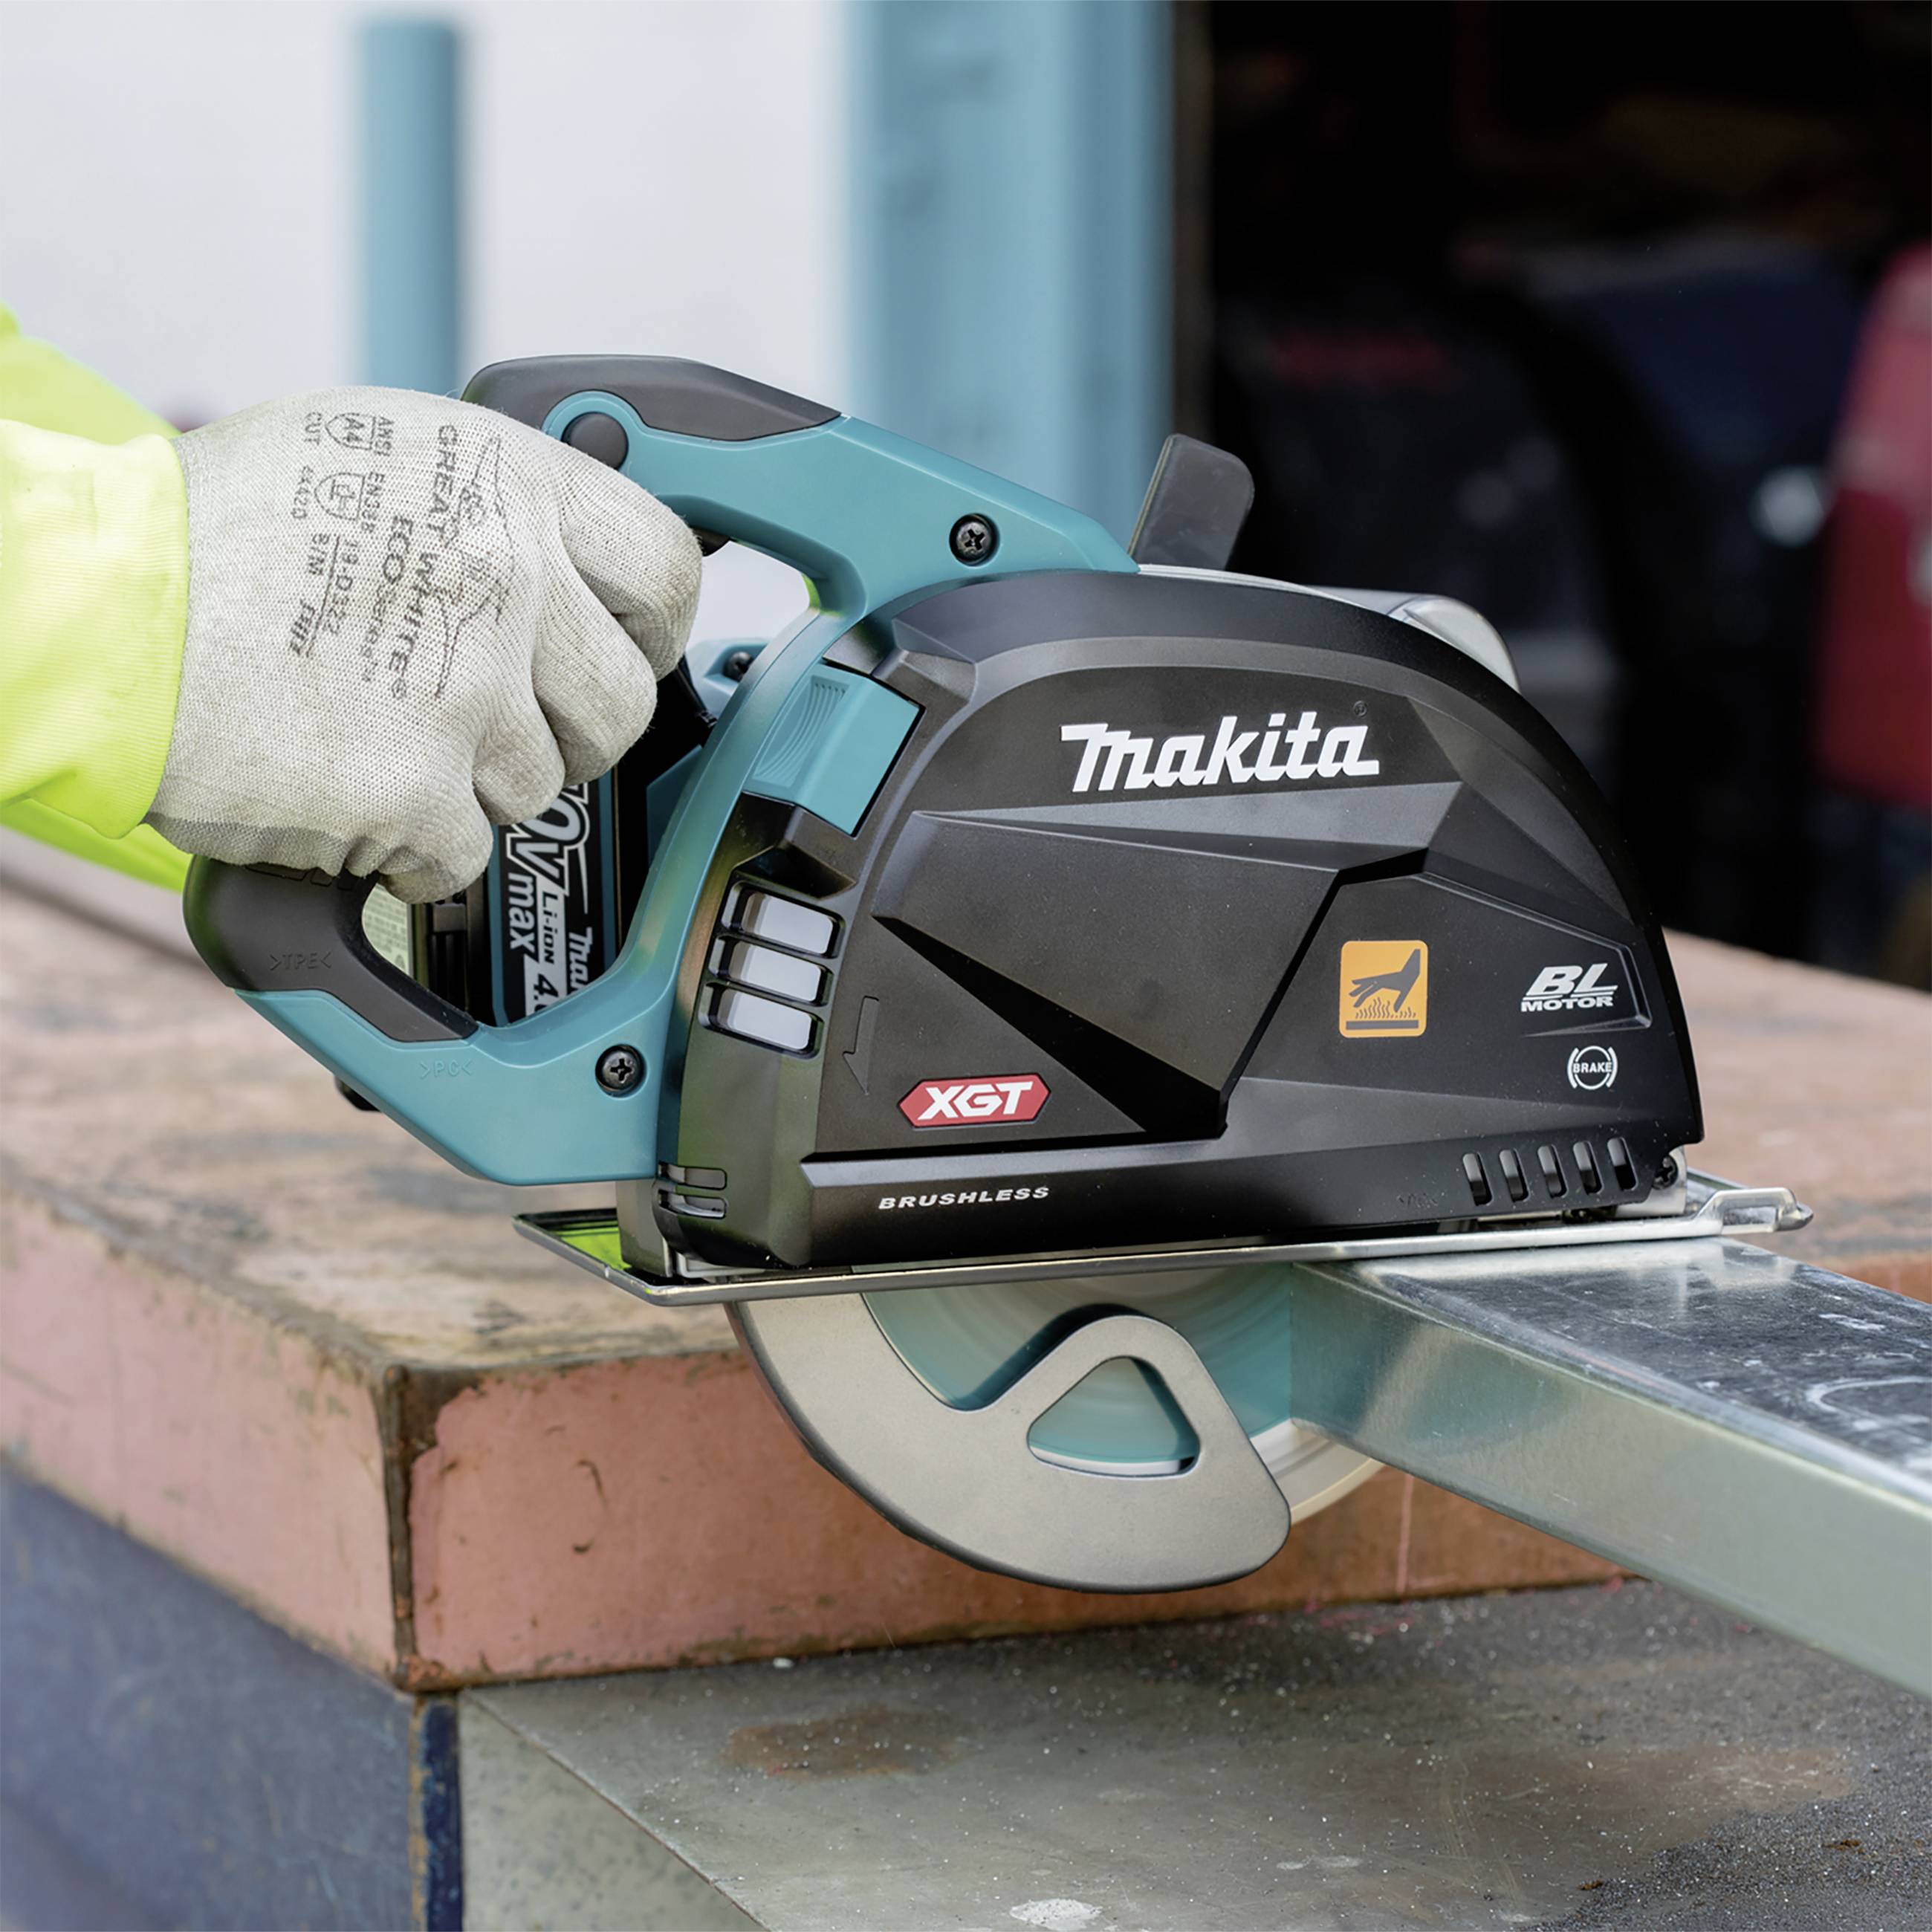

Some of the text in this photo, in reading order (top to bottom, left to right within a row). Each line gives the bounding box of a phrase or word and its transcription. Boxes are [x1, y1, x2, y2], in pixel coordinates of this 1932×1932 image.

[301, 412, 323, 444] CUT
[342, 417, 360, 446] A4
[375, 415, 395, 457] ANSI
[426, 425, 458, 532] GREAT
[363, 473, 386, 532] EN388
[506, 873, 539, 950] max
[1526, 963, 1619, 996] BL
[1522, 996, 1614, 1012] MOTOR
[1572, 1060, 1613, 1074] BRAKE
[918, 1080, 1034, 1120] XGT
[878, 1186, 1049, 1210] BRUSHLESS
